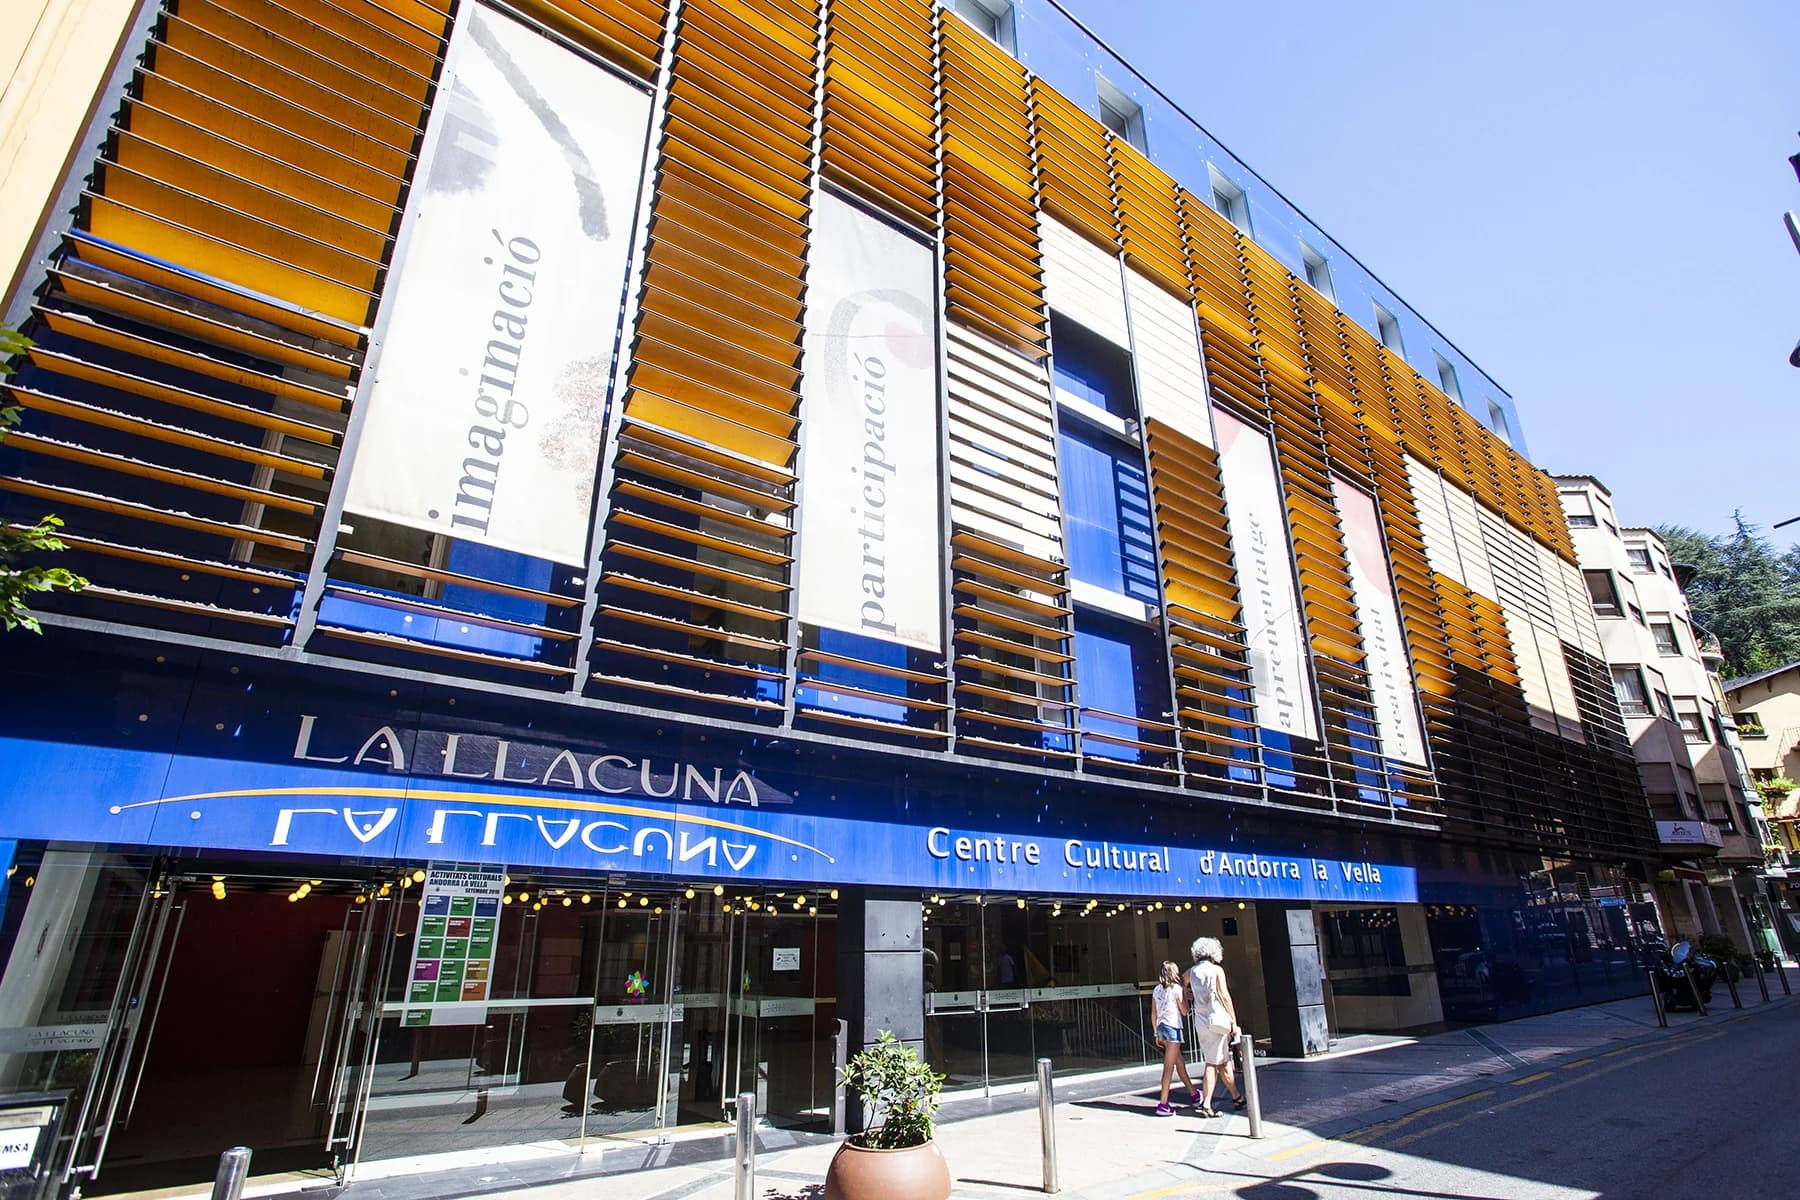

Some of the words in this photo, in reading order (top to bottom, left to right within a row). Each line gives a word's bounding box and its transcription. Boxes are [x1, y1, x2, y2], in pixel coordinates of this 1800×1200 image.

[428, 228, 541, 536] imaginació
[851, 352, 896, 636] participació
[293, 715, 405, 769] LA
[443, 734, 759, 807] LLACUNA
[429, 878, 460, 886] ANDORRA
[470, 880, 488, 888] VELLA
[430, 871, 467, 880] ACTIVITATS
[468, 873, 502, 881] CULTURALS
[927, 826, 1041, 865] Centre
[1064, 839, 1170, 873] Cultural
[1200, 850, 1301, 880] d'Andorra
[1312, 858, 1329, 881] la
[1341, 862, 1382, 885] Vella
